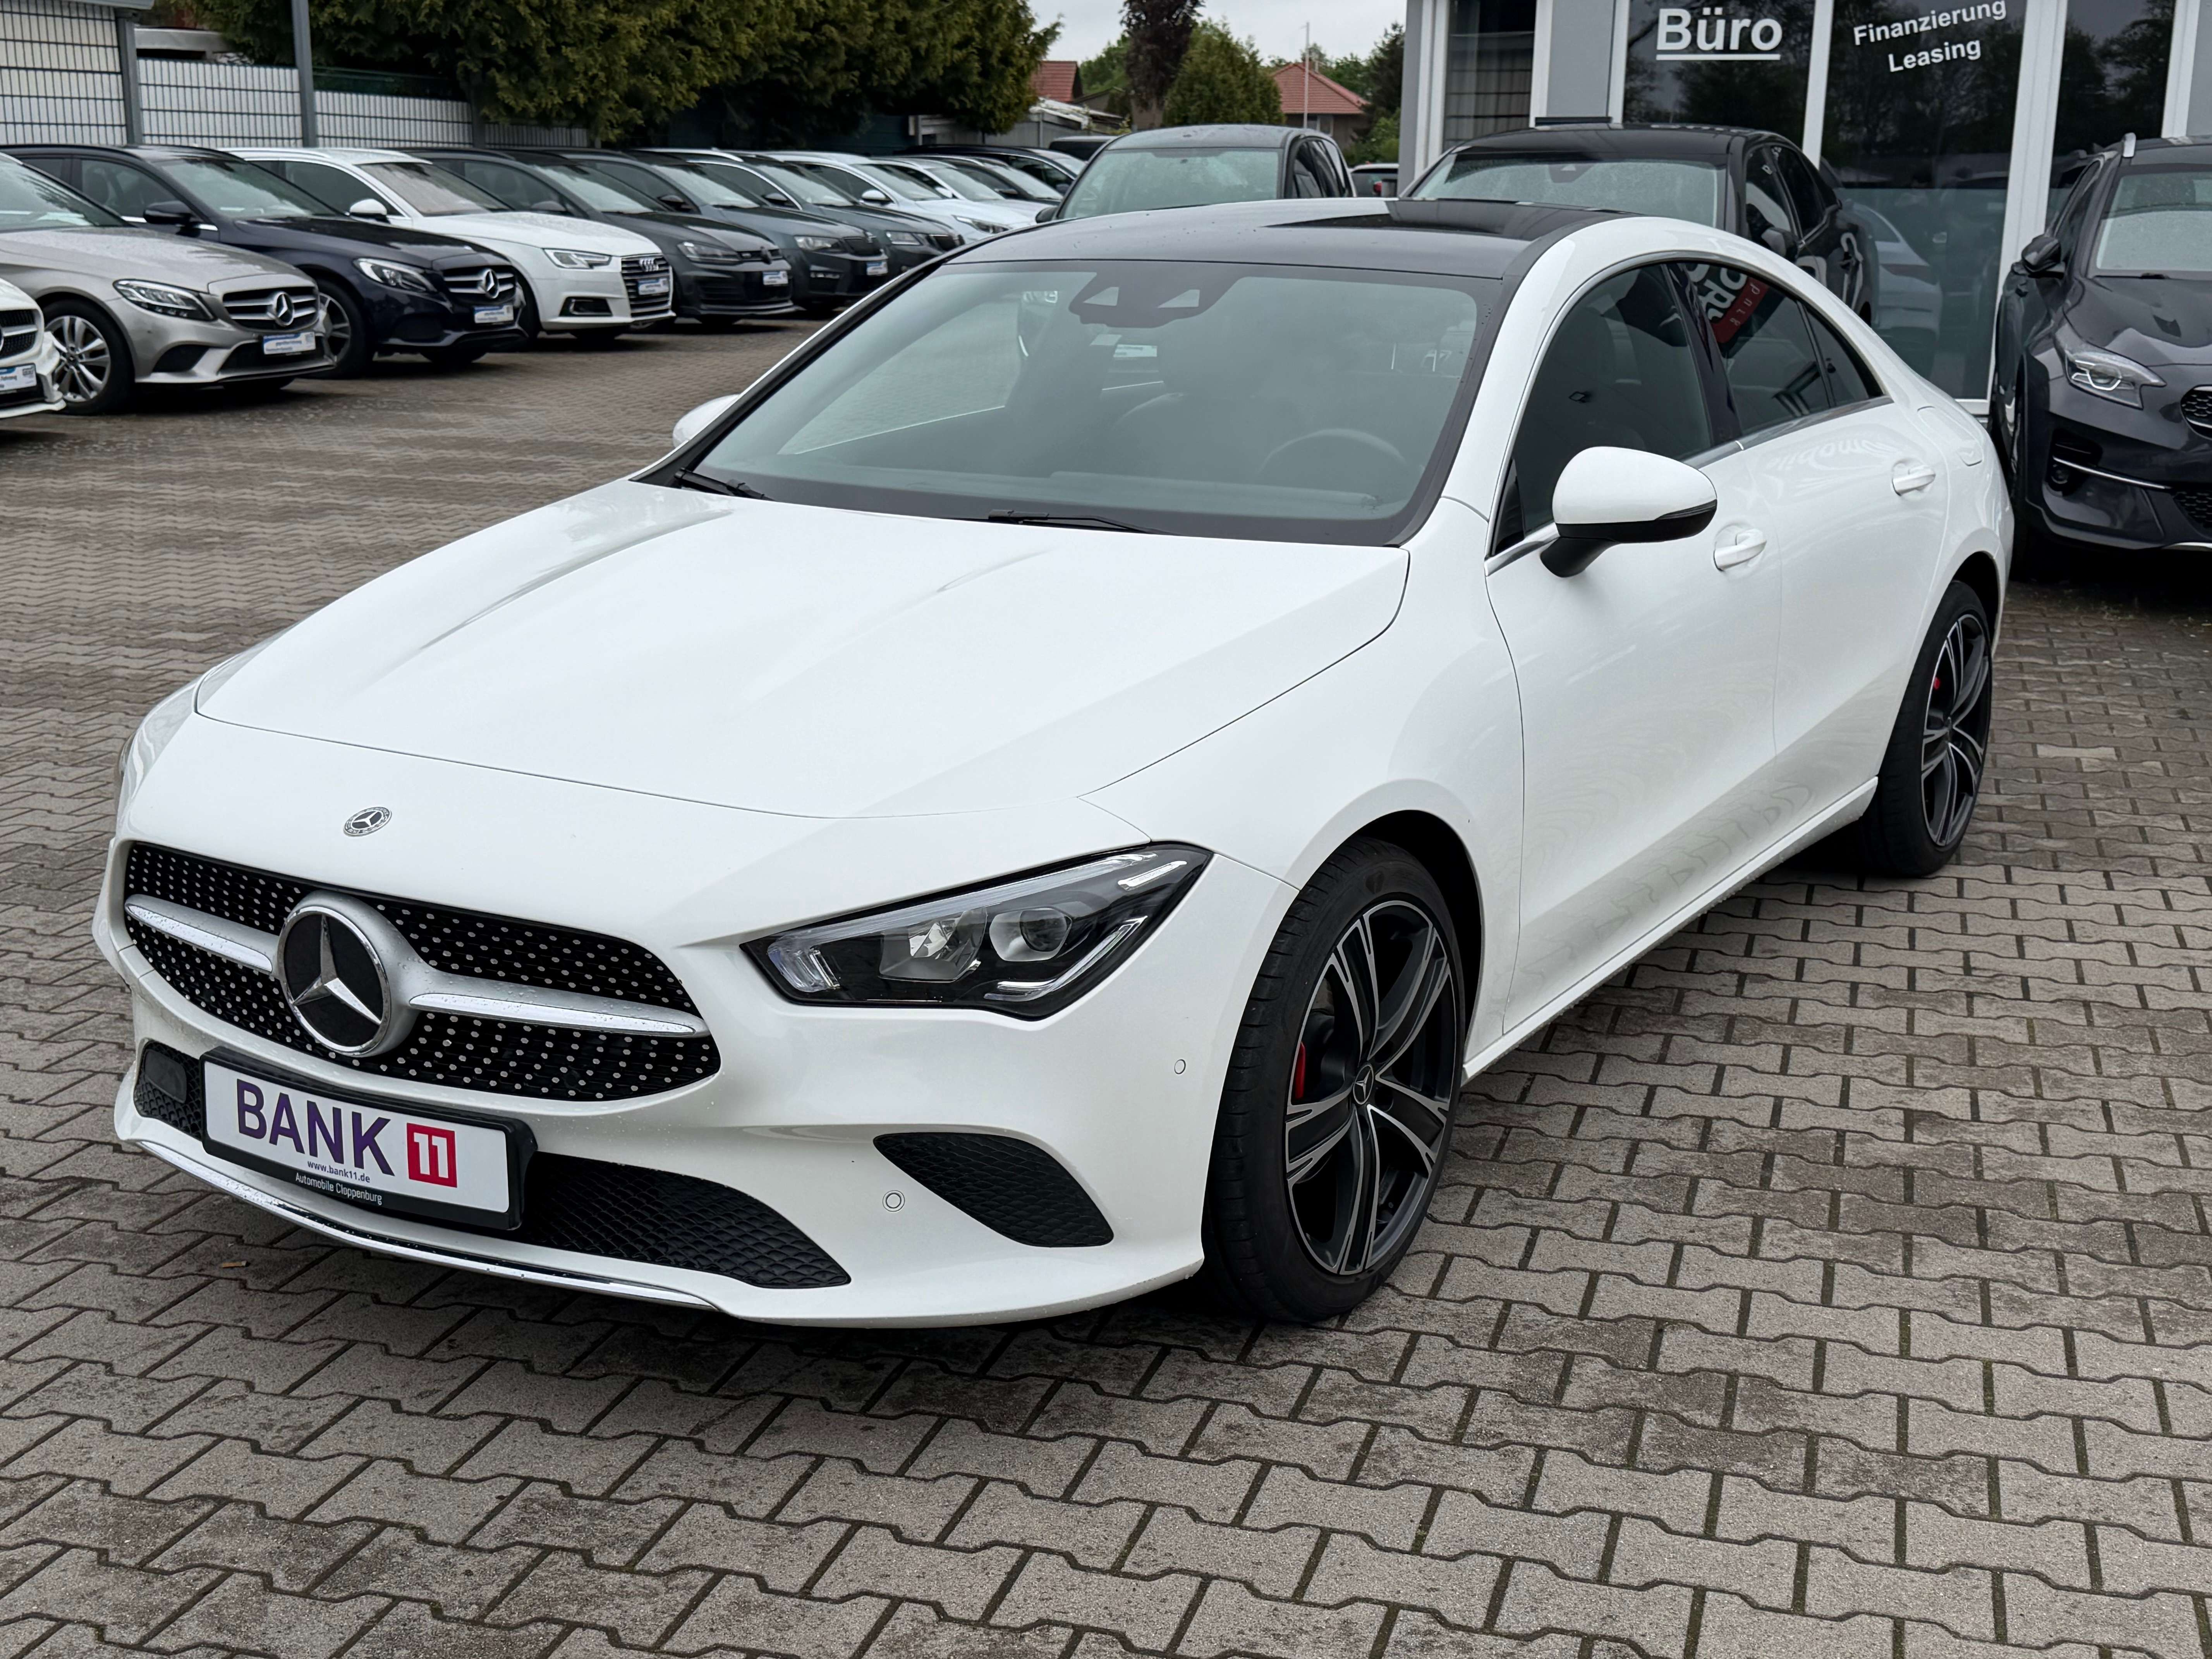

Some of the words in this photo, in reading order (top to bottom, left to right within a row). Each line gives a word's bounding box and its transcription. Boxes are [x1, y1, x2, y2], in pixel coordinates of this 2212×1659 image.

[1657, 7, 1782, 51] Büro
[1853, 0, 2006, 45] Finanzierung
[1888, 40, 1981, 72] Leasing
[237, 1079, 395, 1176] BANK
[412, 1131, 450, 1180] 11
[295, 1172, 334, 1192] Automobile
[336, 1183, 382, 1205] Cloppenburg
[307, 1161, 370, 1182] www.bank11.de
